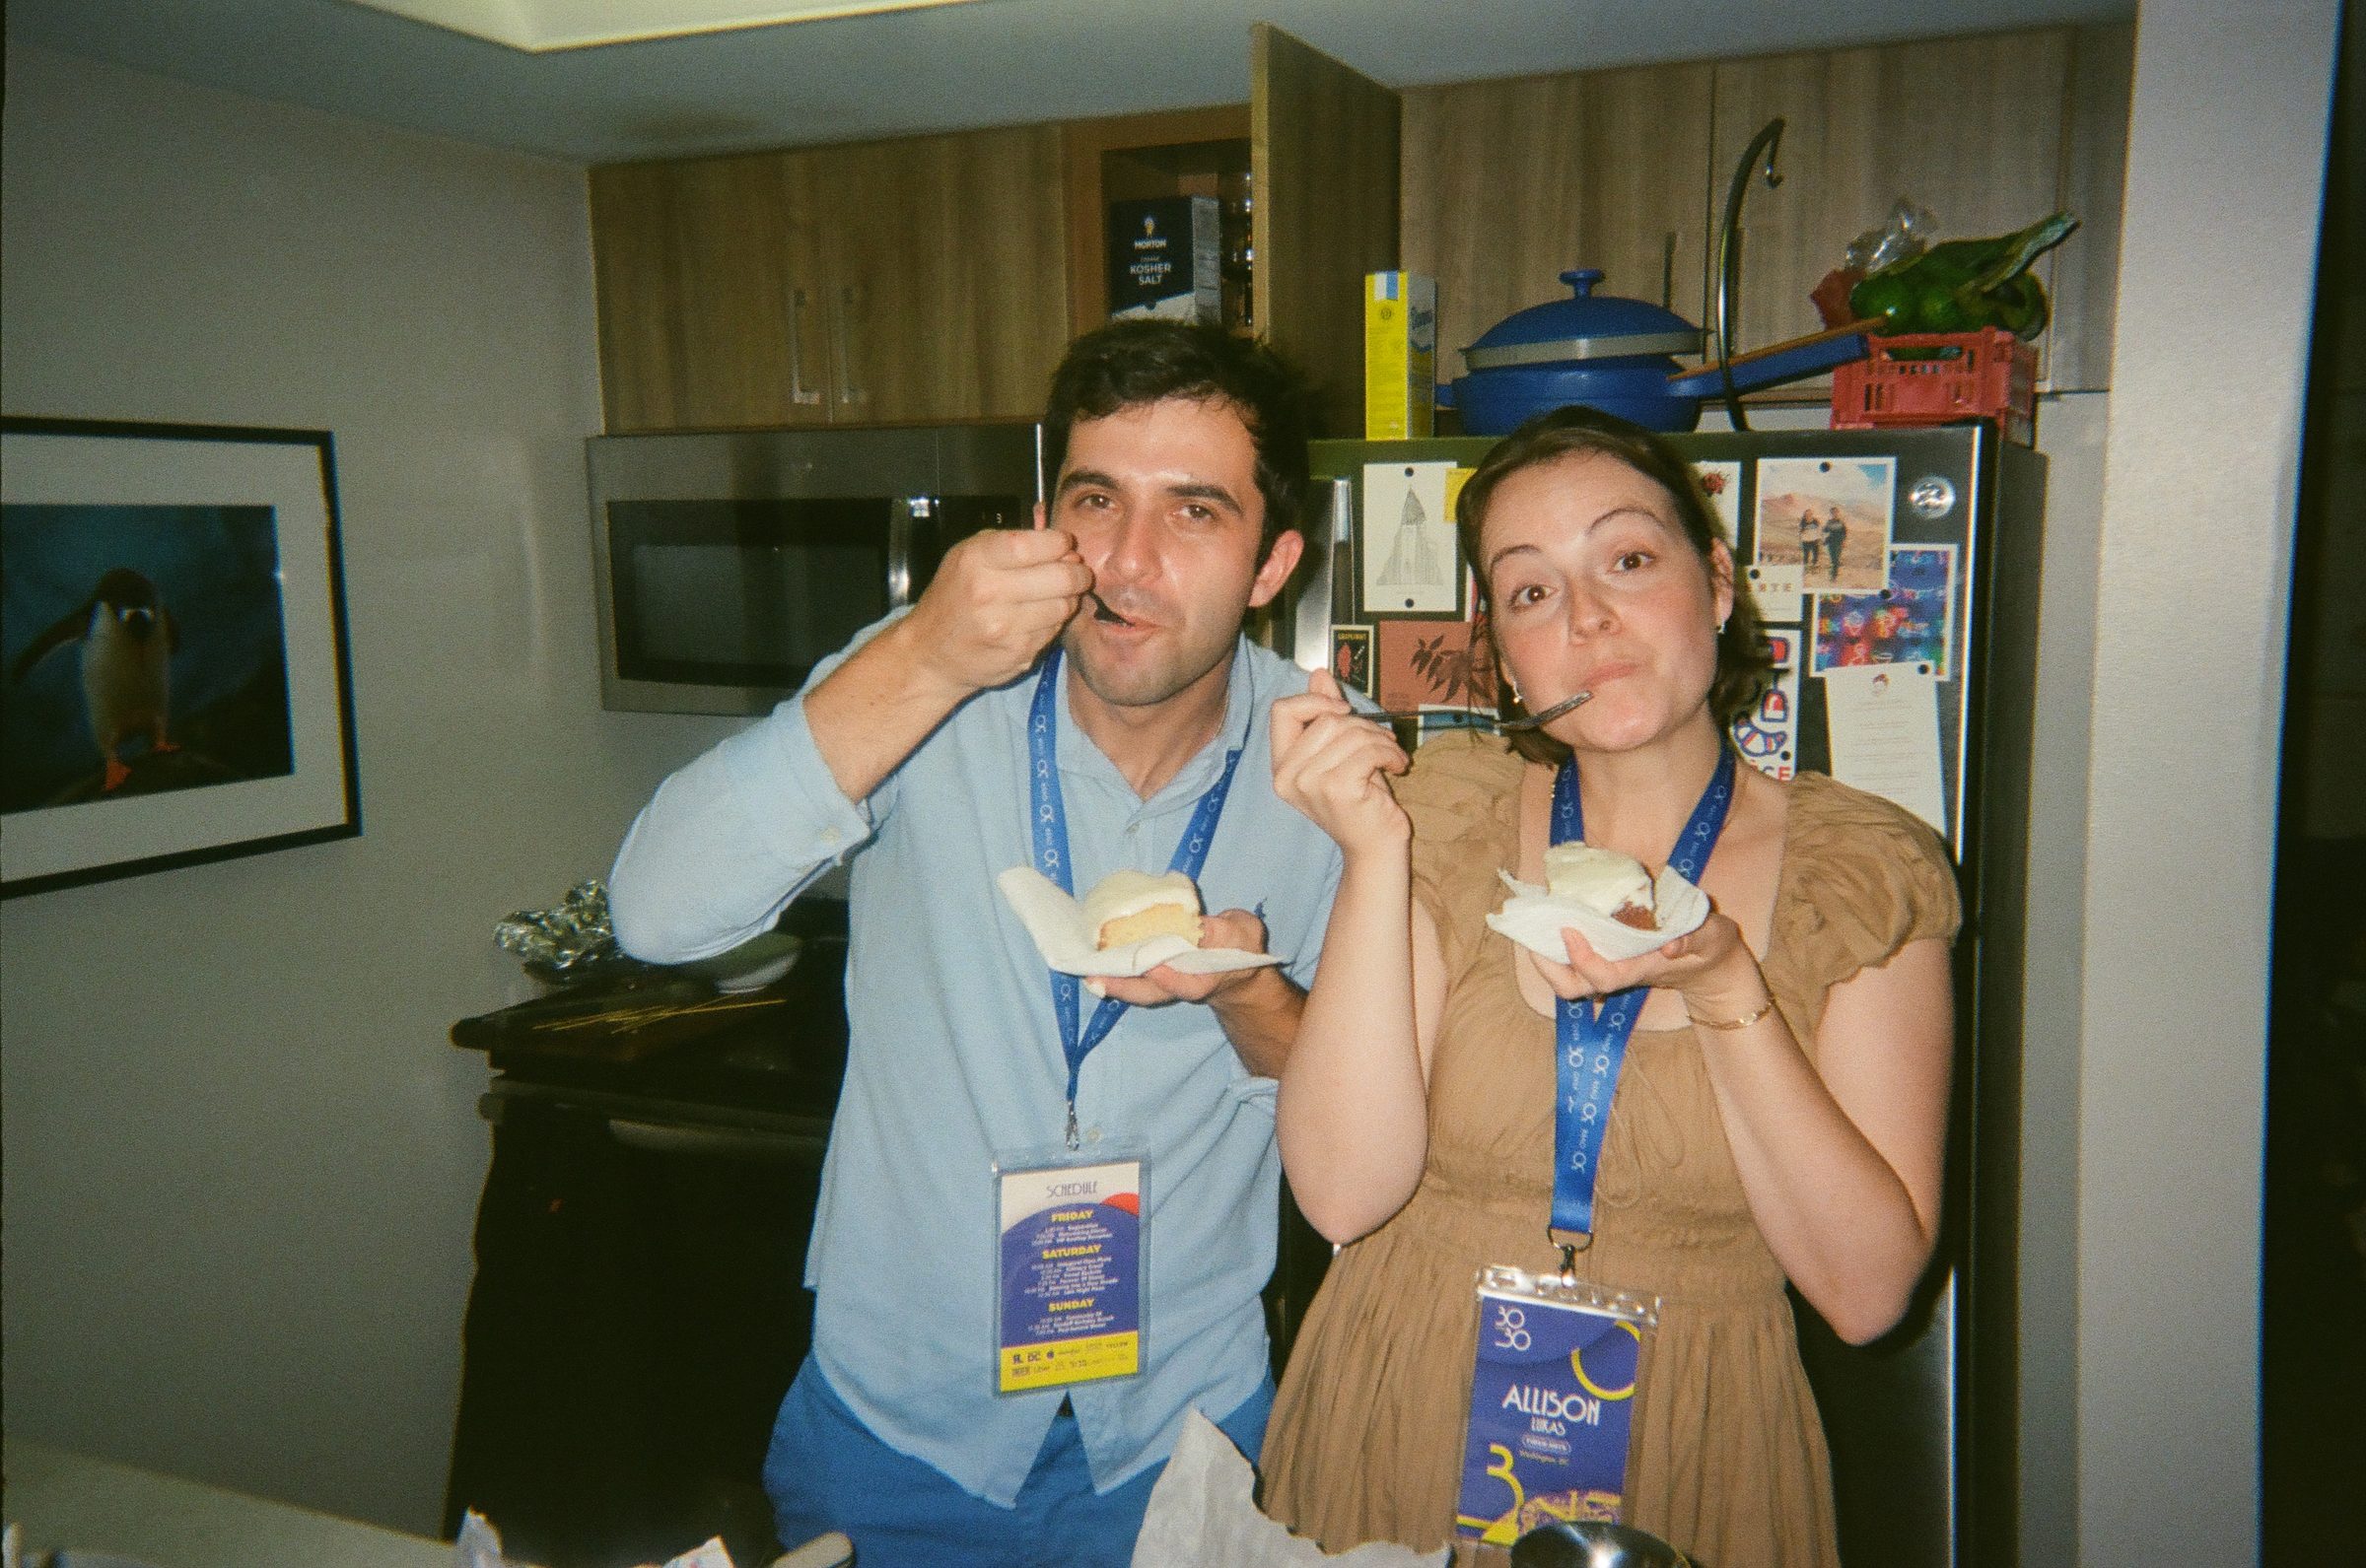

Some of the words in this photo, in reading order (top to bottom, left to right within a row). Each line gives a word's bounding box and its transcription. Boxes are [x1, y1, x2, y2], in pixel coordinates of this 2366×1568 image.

[1130, 263, 1171, 275] KOSHER
[1139, 276, 1161, 286] SALT
[1046, 1181, 1097, 1198] SCHEDULE
[1051, 1209, 1094, 1222] FRIDAY
[1042, 1244, 1101, 1260] SATURDAY
[1048, 1298, 1094, 1313] SUNDAY
[1501, 1383, 1601, 1426] ALLISON
